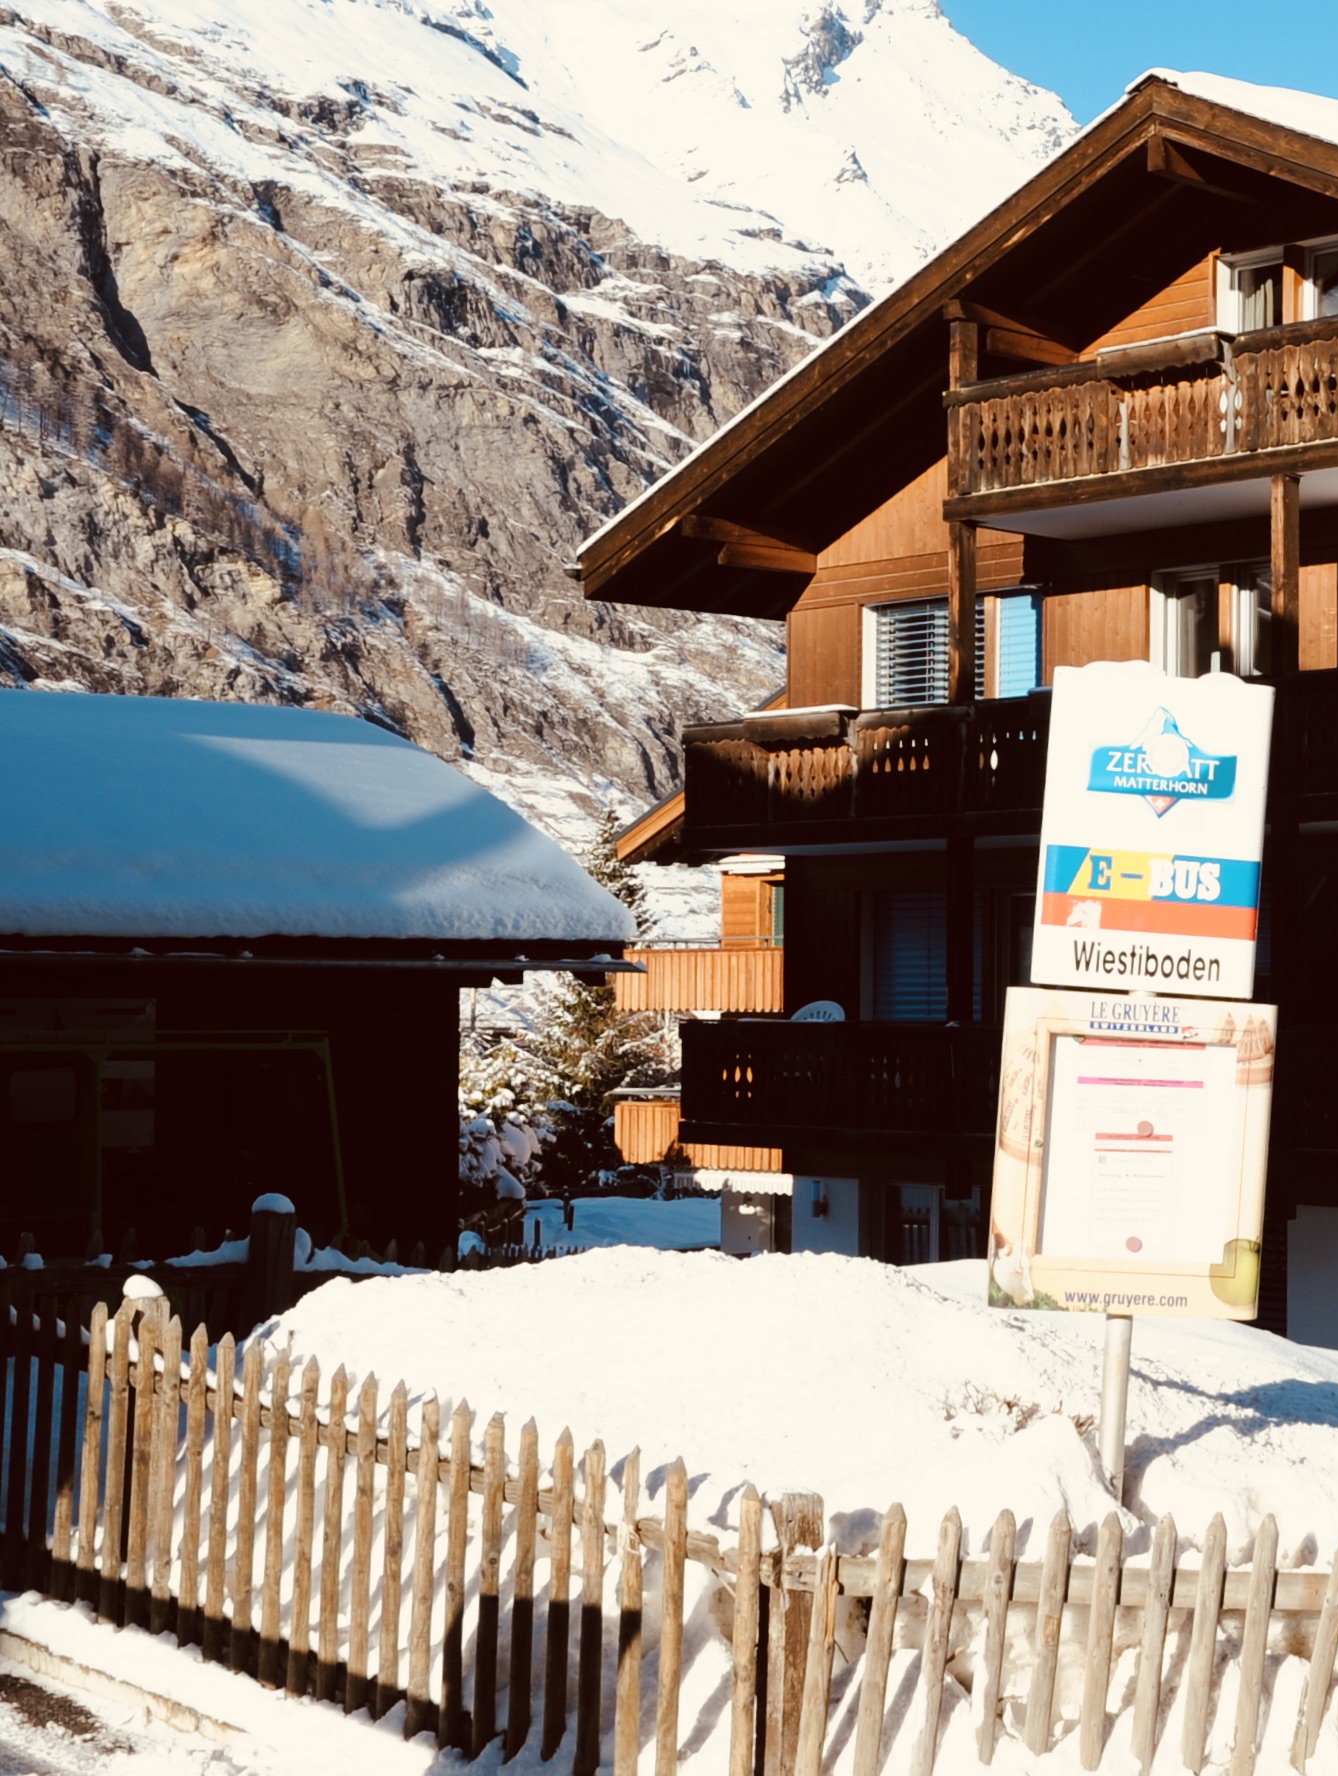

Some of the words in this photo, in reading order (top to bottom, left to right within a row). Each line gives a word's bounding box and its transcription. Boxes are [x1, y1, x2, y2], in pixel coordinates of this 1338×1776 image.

[1106, 751, 1220, 780] ZERATT
[1113, 775, 1208, 795] MATTERHORN
[1074, 940, 1220, 982] Wiestiboden
[1091, 1001, 1108, 1019] LE
[1112, 1003, 1180, 1023] GRUYÈRE
[1065, 1291, 1188, 1307] www.gruyere.com
